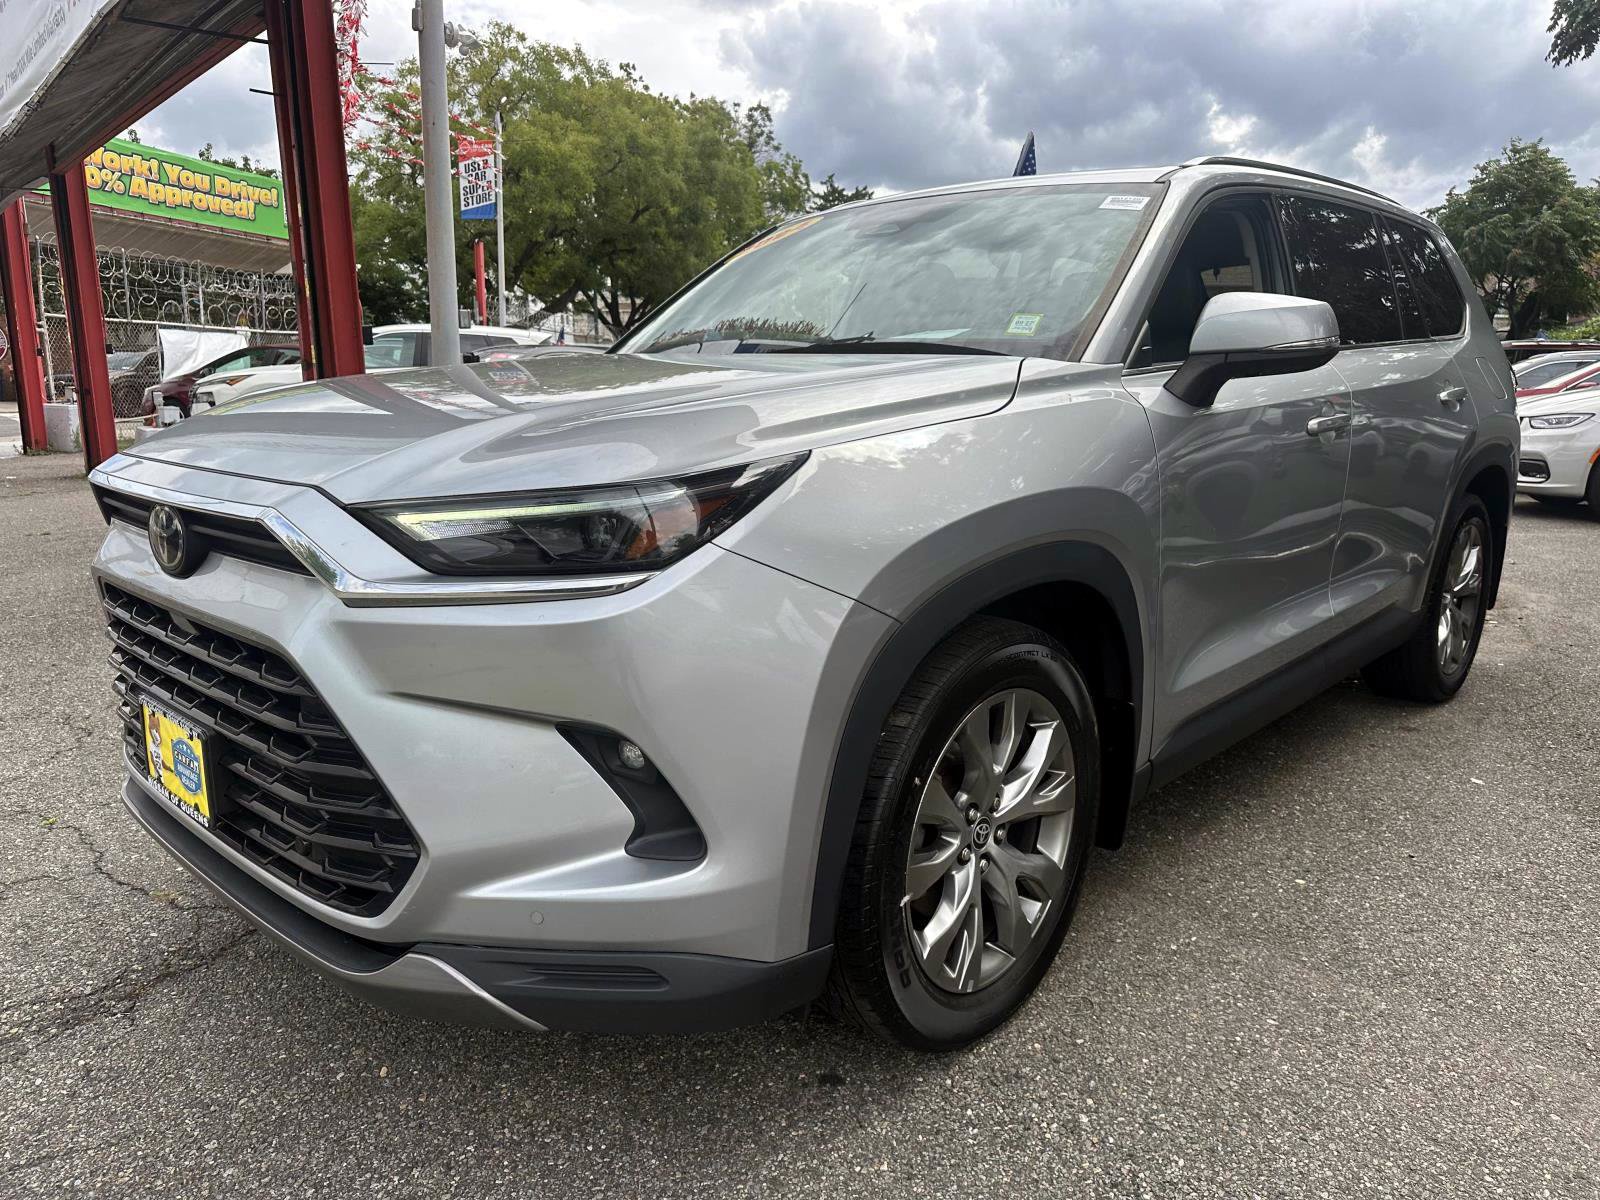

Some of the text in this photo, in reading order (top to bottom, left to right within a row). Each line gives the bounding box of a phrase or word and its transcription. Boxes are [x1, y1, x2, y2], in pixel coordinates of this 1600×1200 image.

[464, 159, 490, 174] USED
[161, 160, 211, 193] You
[213, 174, 279, 209] Drive!
[468, 171, 487, 185] CAR
[129, 175, 256, 221] Approved!
[462, 181, 493, 197] SUPER
[463, 191, 493, 208] STORE
[147, 774, 170, 800] NISSAN
[170, 793, 209, 829] OF QUEENS
